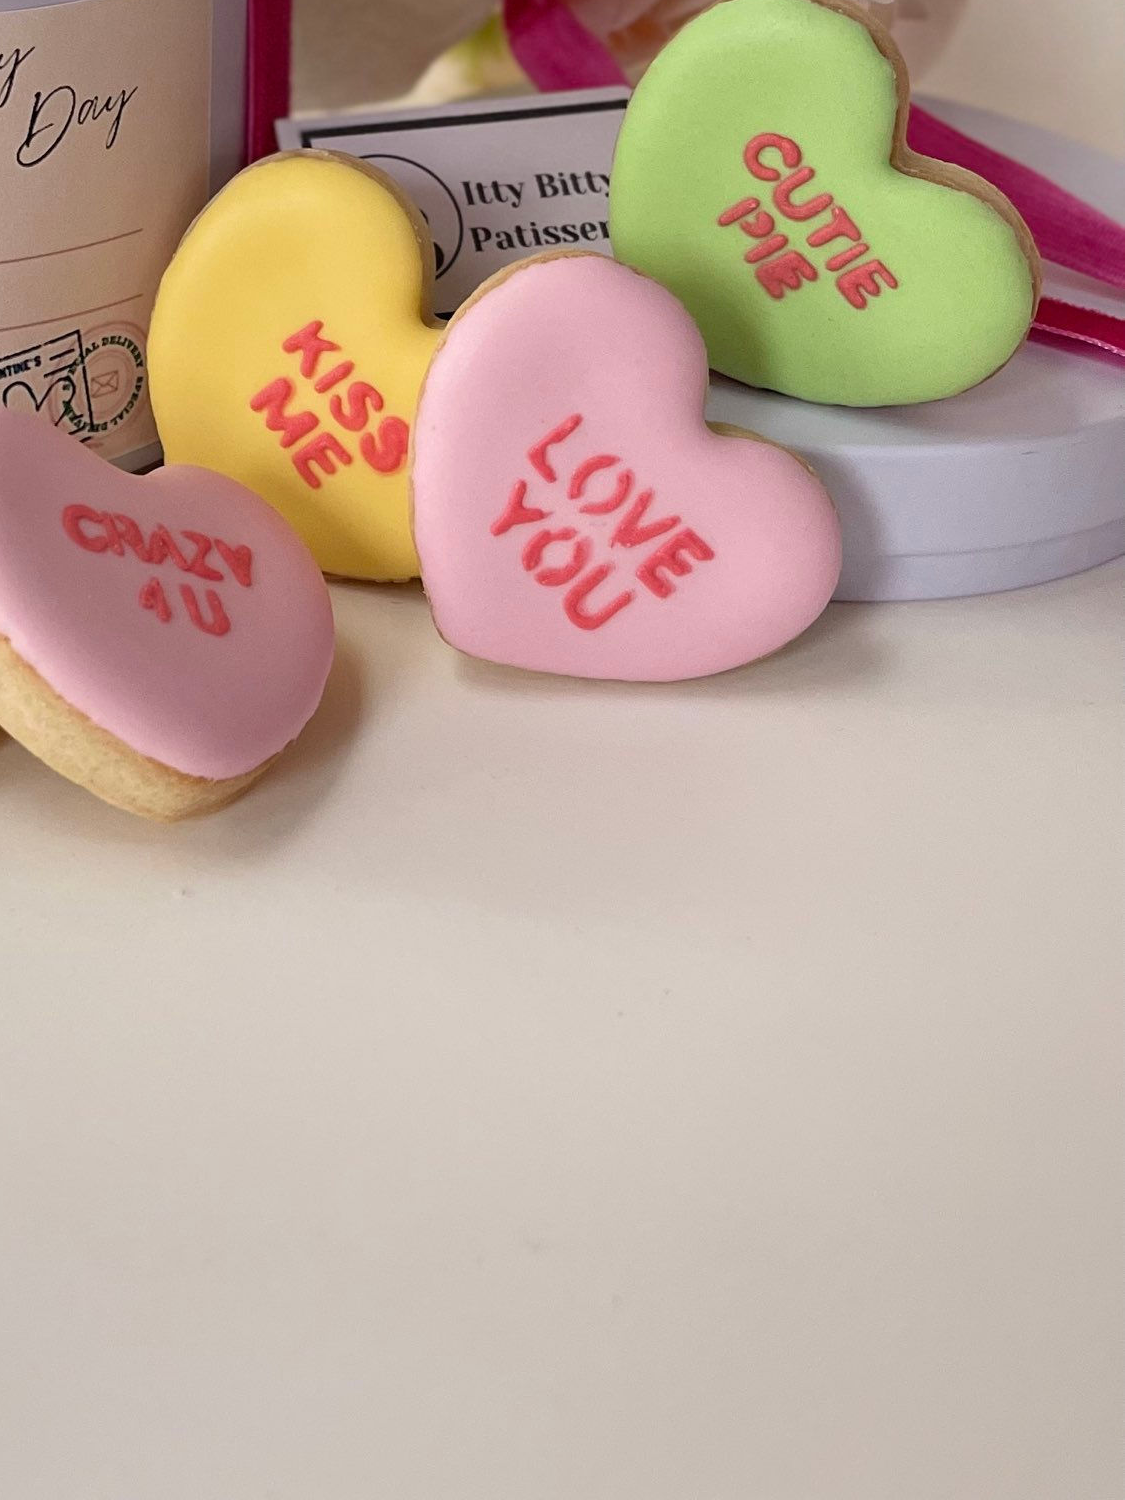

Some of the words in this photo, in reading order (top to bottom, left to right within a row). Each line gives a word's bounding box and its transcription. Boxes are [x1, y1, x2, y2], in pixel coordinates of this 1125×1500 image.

[16, 85, 138, 168] Day
[460, 179, 524, 209] Itty
[743, 132, 899, 310] CUTIE
[717, 196, 819, 300] PIE
[101, 335, 144, 368] DELIVERY
[282, 320, 410, 474] KISS
[250, 377, 353, 490] ME
[62, 503, 253, 588] CRAZY
[490, 478, 635, 630] YOU
[528, 413, 715, 599] LOVE
[179, 583, 232, 637] U
